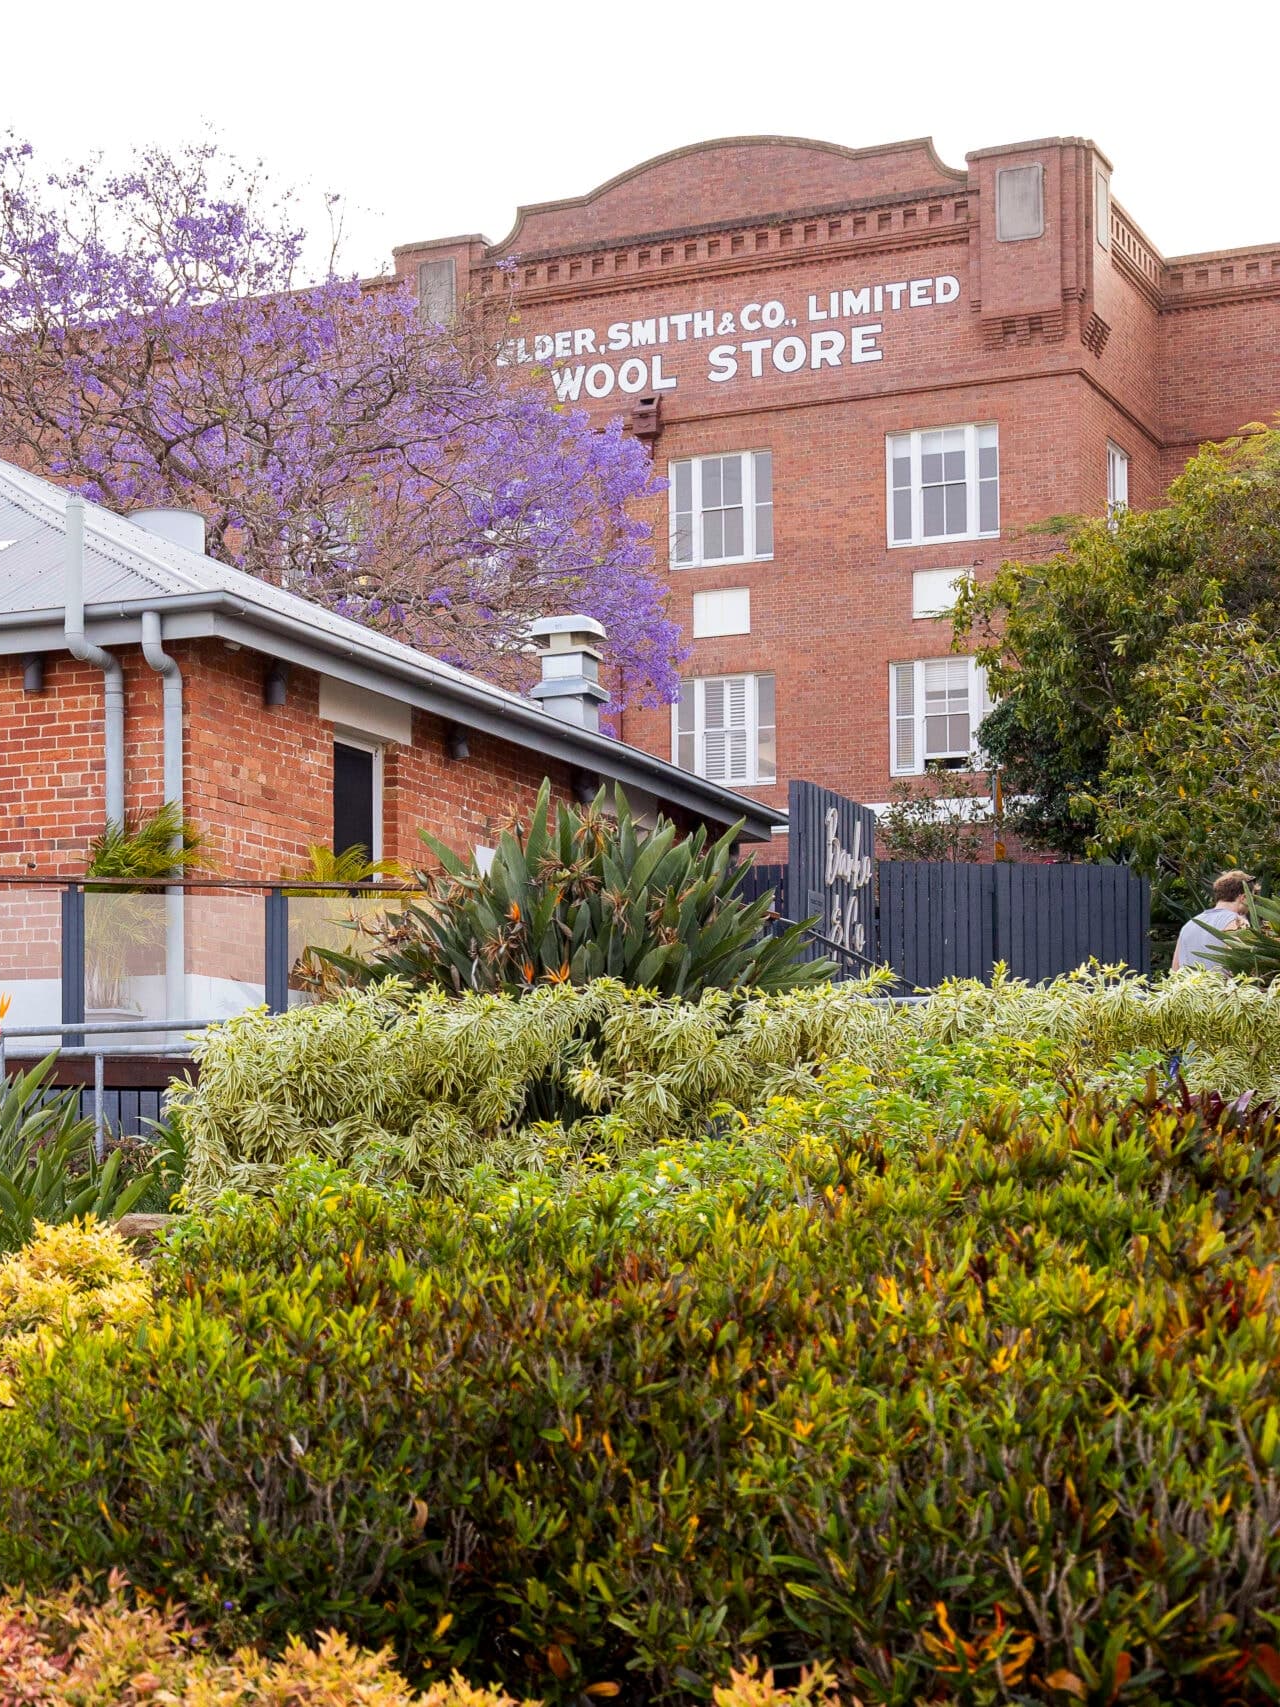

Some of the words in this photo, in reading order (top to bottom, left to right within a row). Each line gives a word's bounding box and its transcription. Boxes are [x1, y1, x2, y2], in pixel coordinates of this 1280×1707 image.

[808, 274, 961, 321] LIMITED
[551, 355, 678, 402] WOOL
[707, 324, 884, 383] STORE
